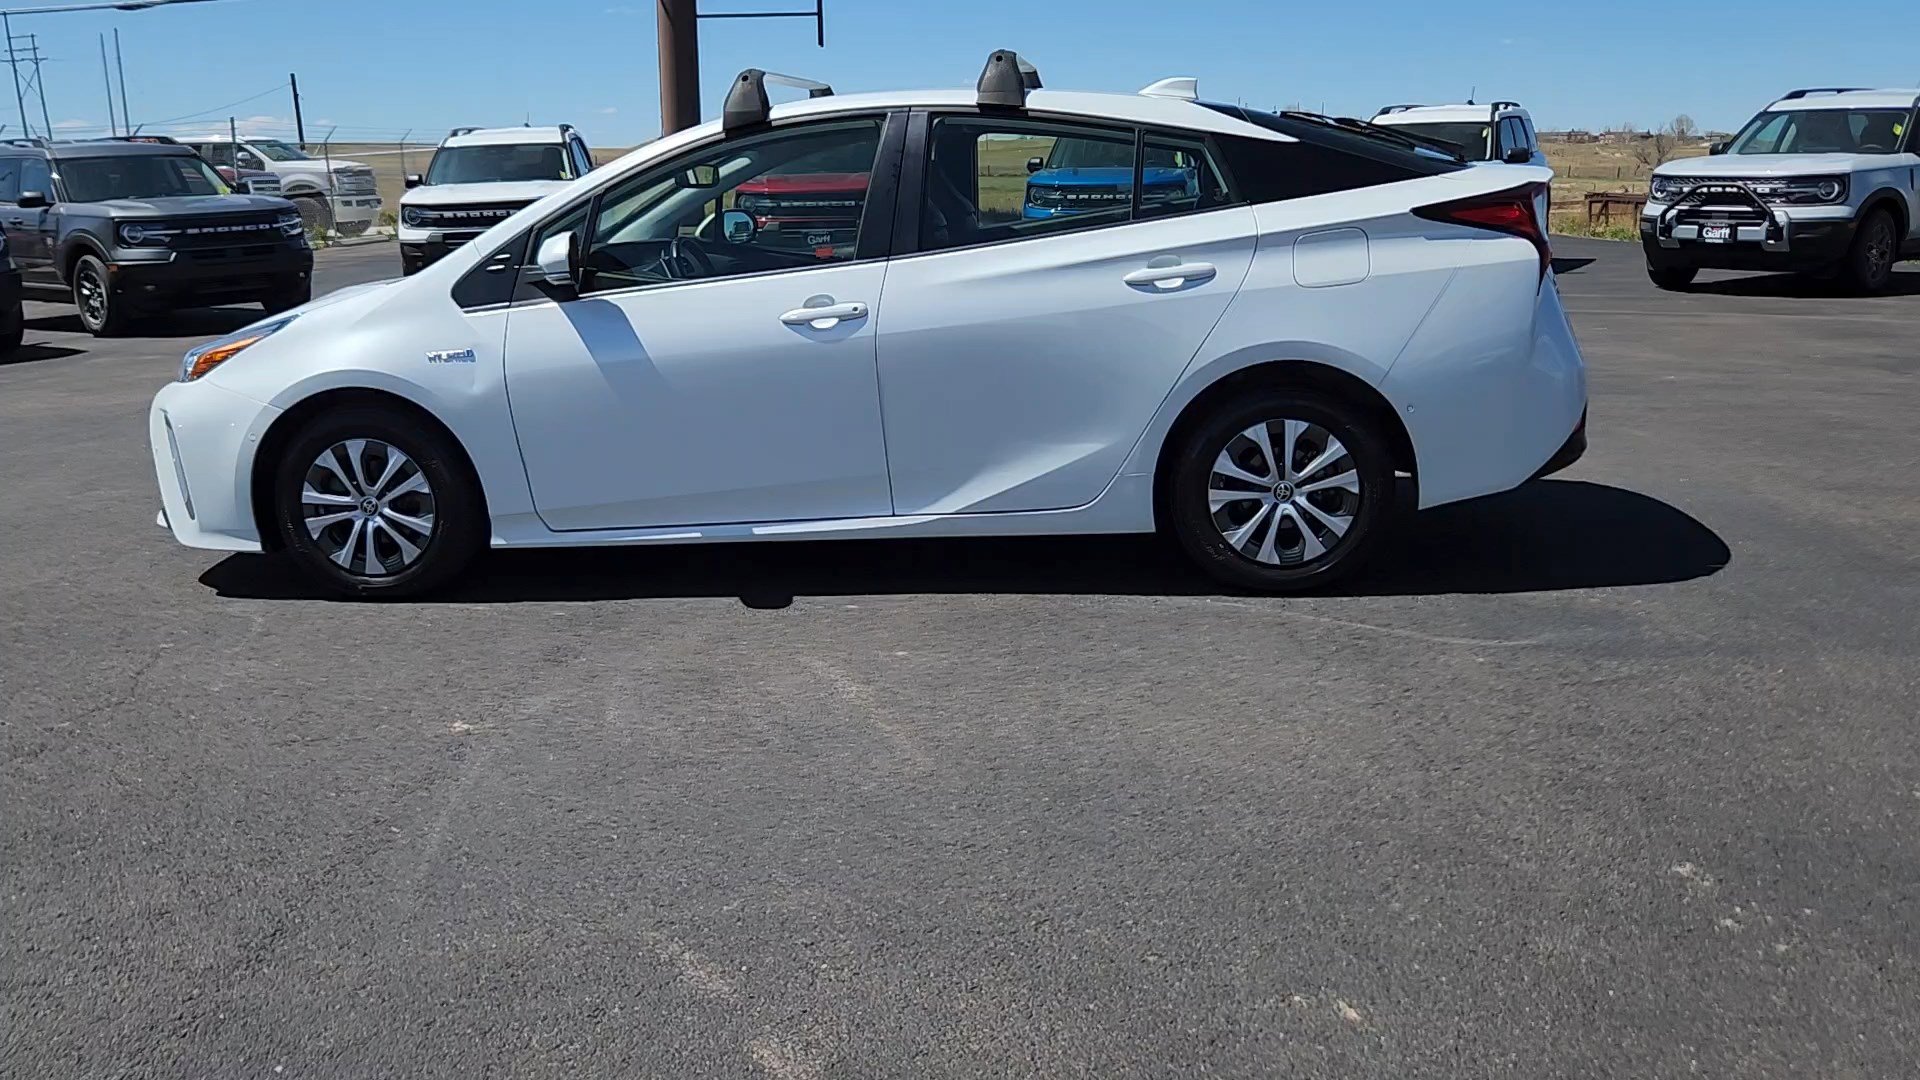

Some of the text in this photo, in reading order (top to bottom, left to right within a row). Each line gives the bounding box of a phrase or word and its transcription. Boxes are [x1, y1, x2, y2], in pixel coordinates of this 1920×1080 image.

[1682, 186, 1770, 194] BRONO
[186, 223, 270, 234] BRONCO
[807, 234, 831, 245] Garff
